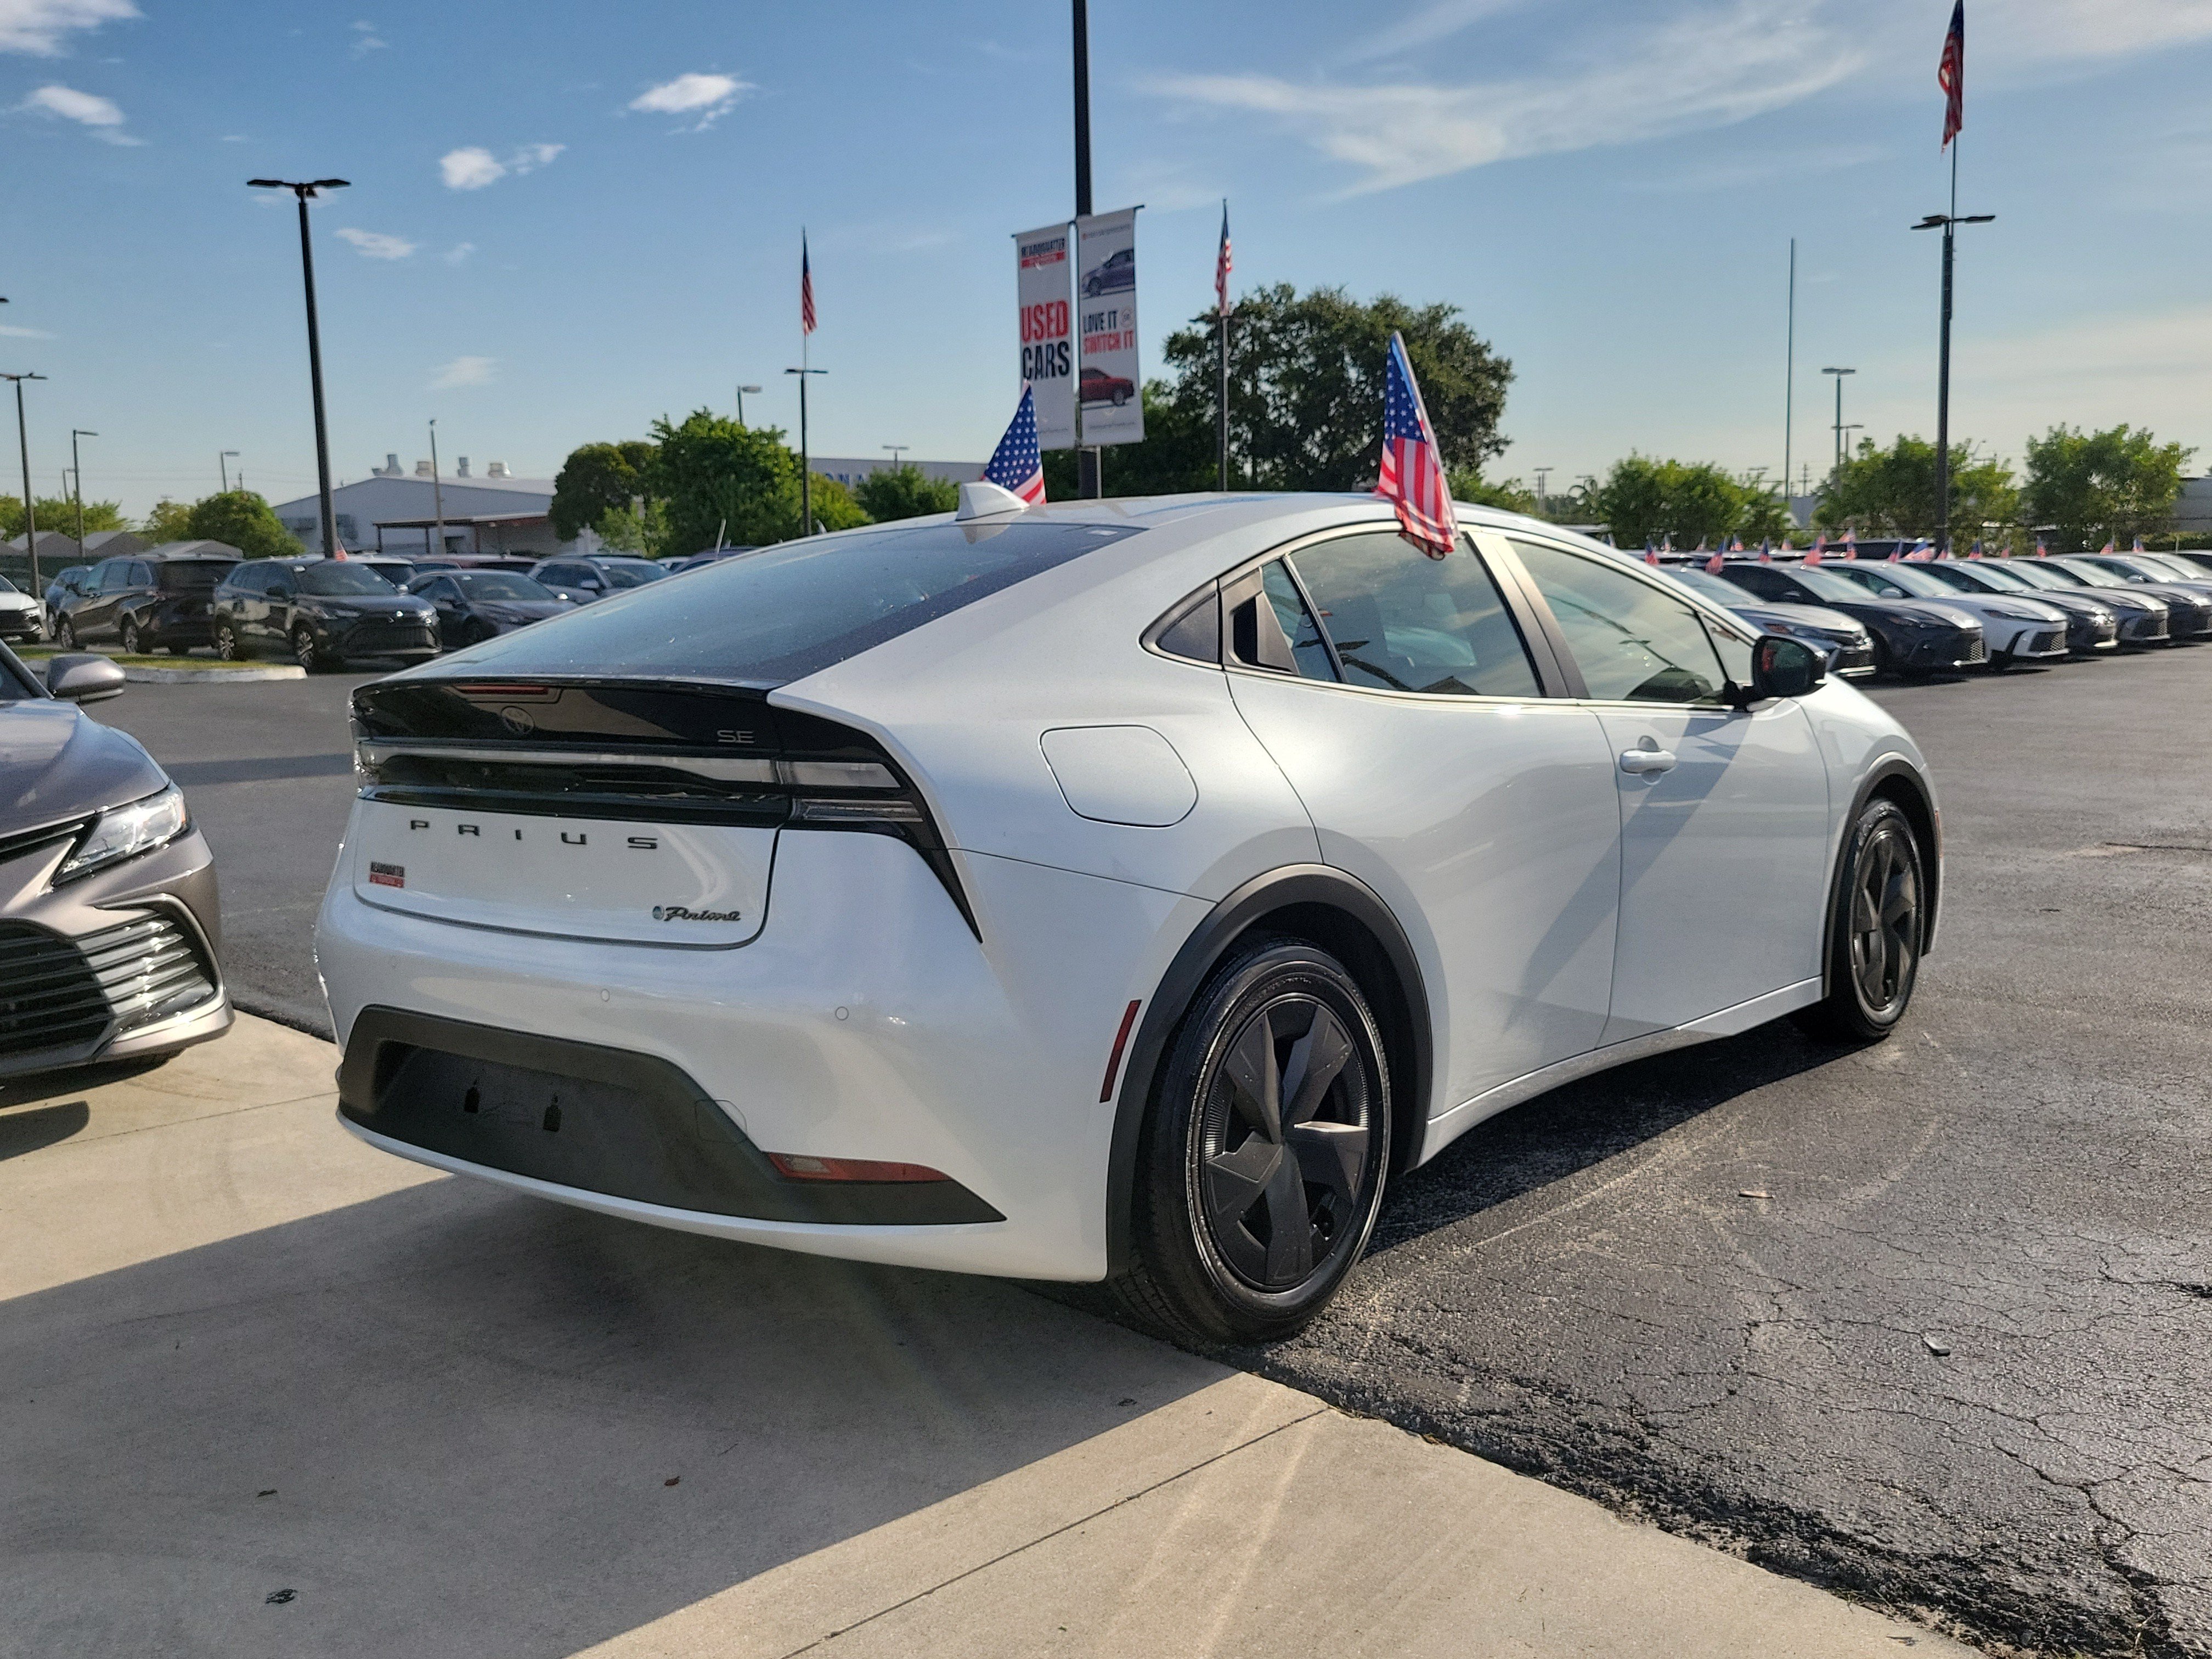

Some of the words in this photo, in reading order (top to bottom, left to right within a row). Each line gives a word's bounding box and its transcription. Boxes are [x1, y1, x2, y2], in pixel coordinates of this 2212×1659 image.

[1022, 300, 1068, 343] USED
[1083, 312, 1104, 334] LOVE
[1108, 311, 1117, 330] IT
[1124, 330, 1133, 349] IT
[1023, 341, 1069, 380] CARS
[716, 730, 755, 743] SE
[410, 820, 658, 850] PRIUS
